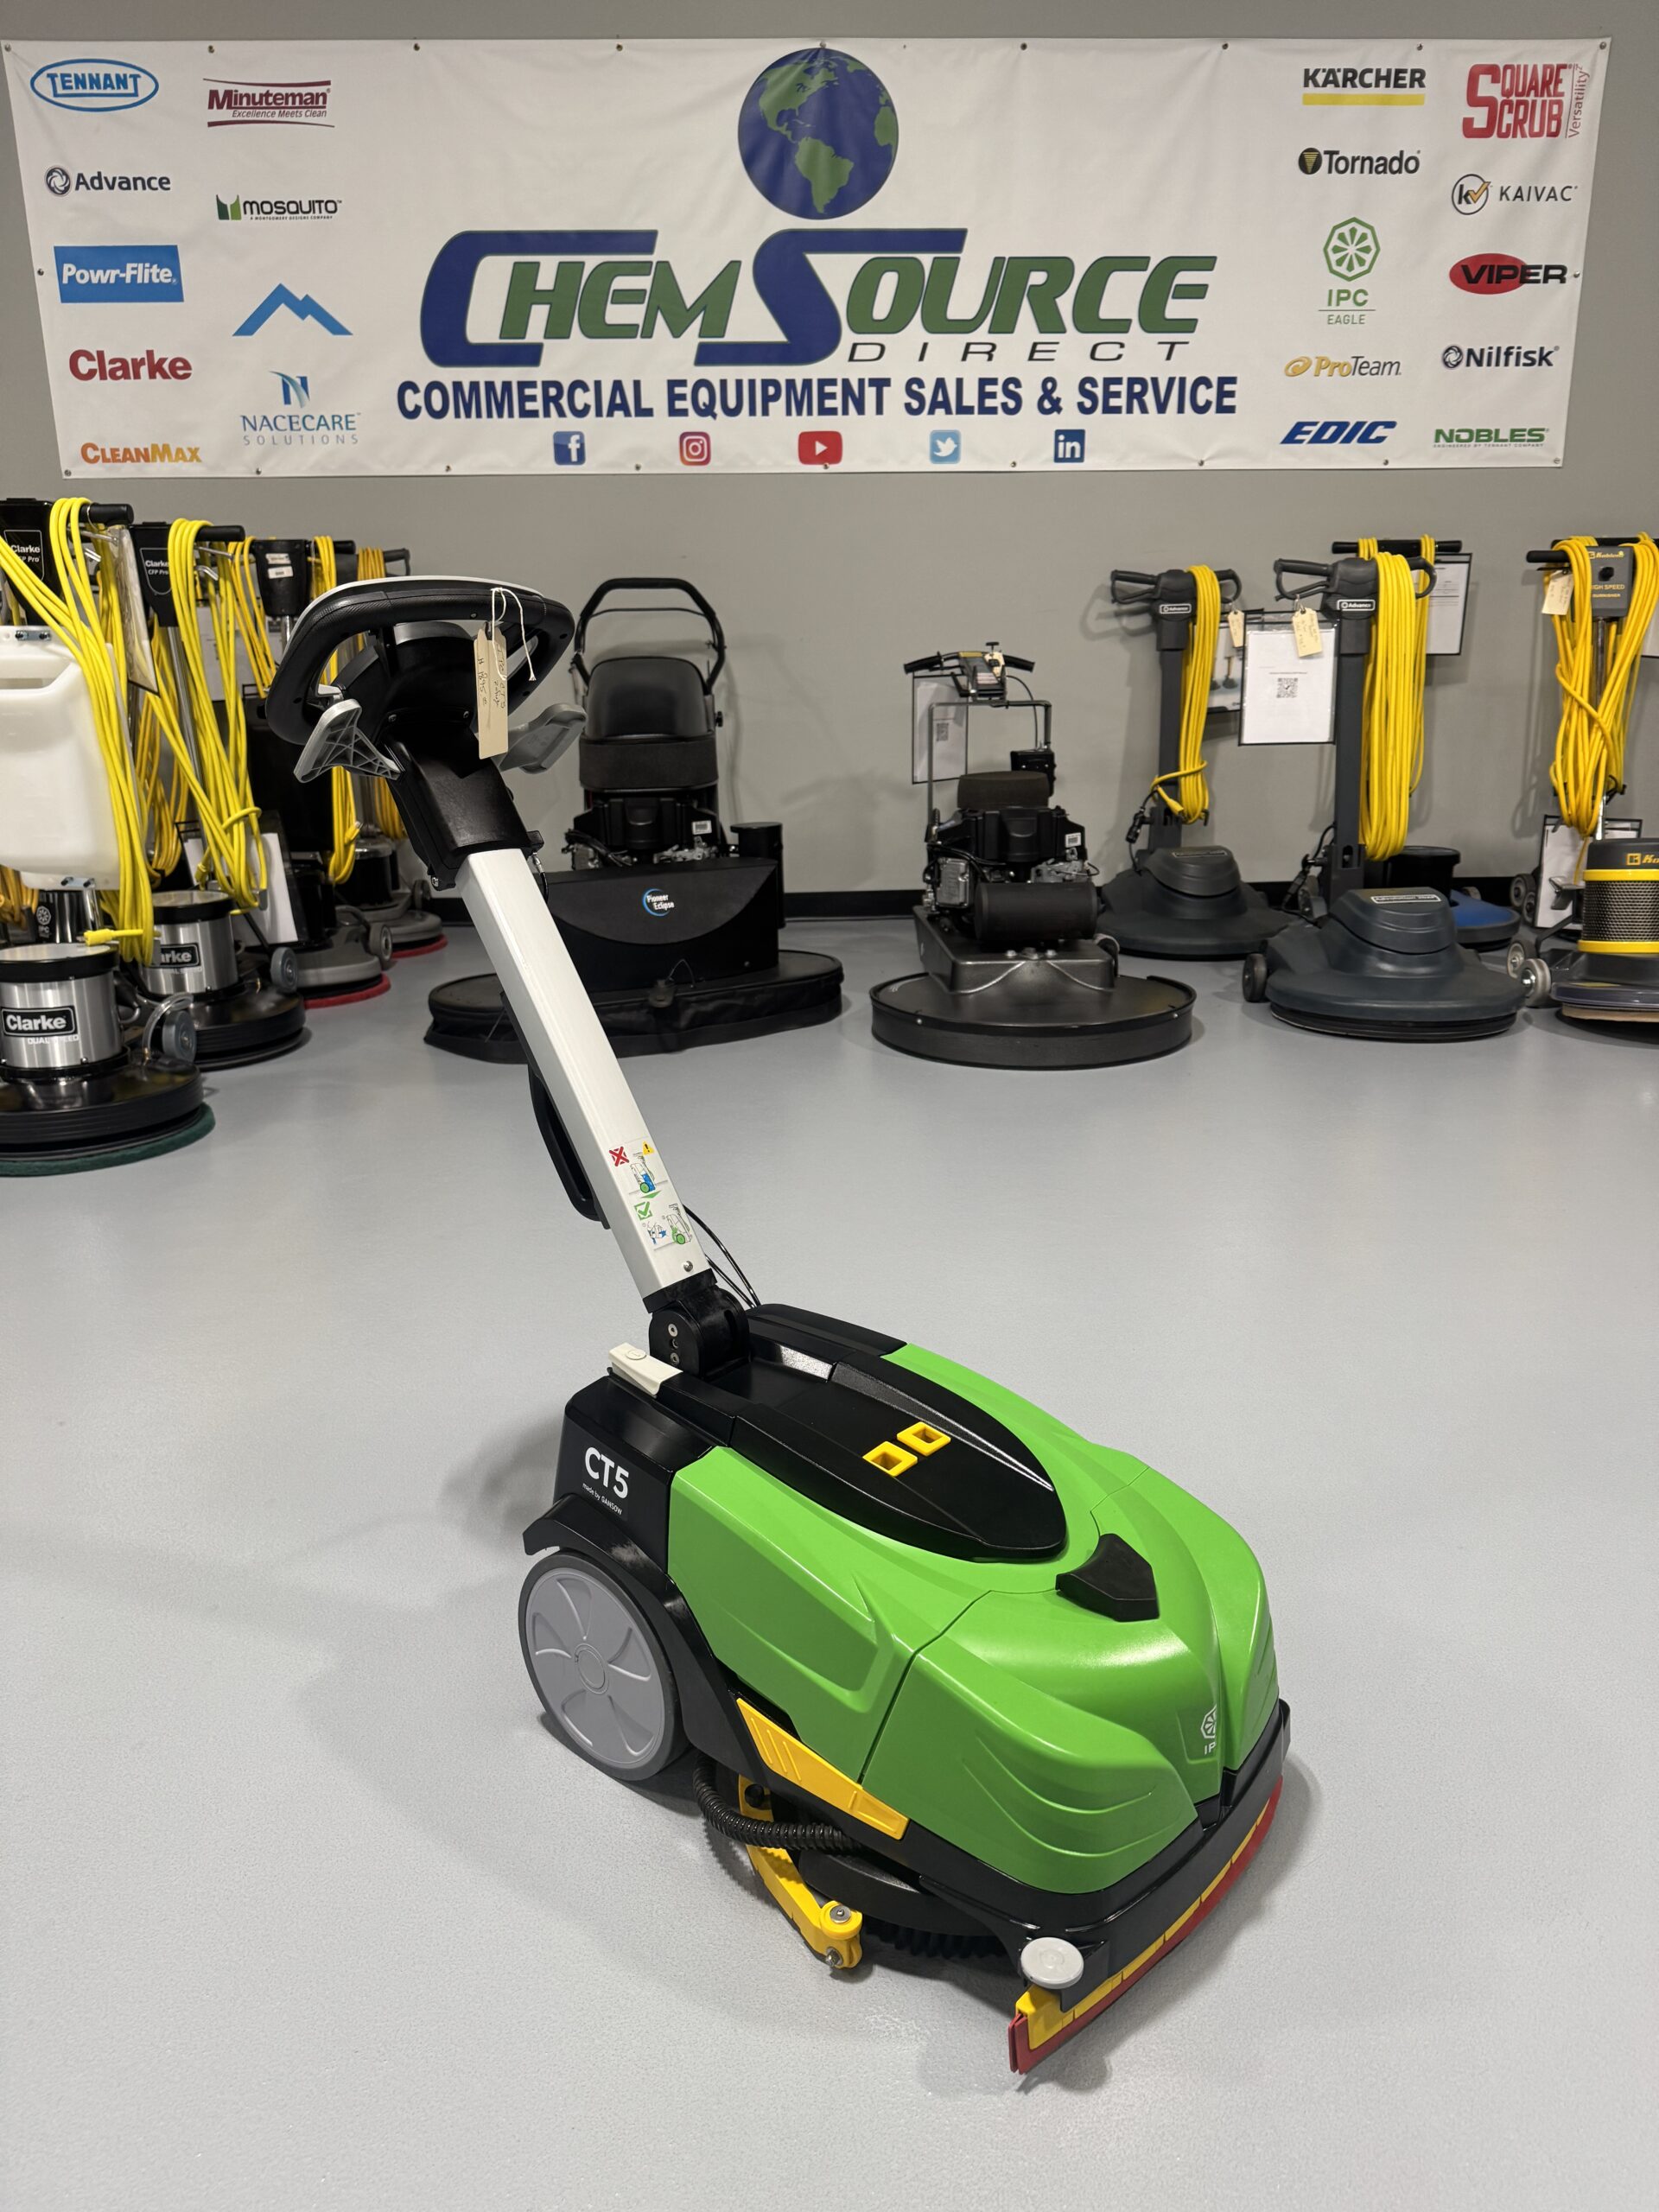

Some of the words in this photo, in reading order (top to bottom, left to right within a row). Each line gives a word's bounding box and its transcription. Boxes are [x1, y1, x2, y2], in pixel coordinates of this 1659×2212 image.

[47, 73, 141, 92] TENNANT
[1303, 67, 1426, 89] KÄRCHER
[208, 89, 327, 110] Minuteman
[1324, 150, 1420, 175] Tornado
[74, 171, 171, 192] Advance
[1500, 186, 1573, 201] KAIVAC
[62, 263, 174, 284] Powr-Flite
[1460, 264, 1567, 284] VIPER
[1328, 289, 1369, 307] IPC
[1327, 314, 1366, 325] EAGLE
[847, 341, 1190, 362] DIRECT
[1465, 346, 1554, 367] Nilfisk
[69, 349, 192, 381] Clarke
[1314, 356, 1401, 377] ProTeam
[397, 379, 653, 419] COMMERCIAL
[667, 377, 891, 420] EQUIPMENT
[904, 377, 1022, 416] SALES
[1037, 377, 1064, 415] &
[1077, 376, 1237, 415] SERVICE
[240, 414, 358, 431] NACECARE
[1280, 421, 1397, 445] EDIC
[243, 434, 359, 446] SOLUTIONS
[1434, 428, 1545, 443] NOBLES
[10, 544, 41, 553] Clarke
[646, 894, 668, 903] Pioneer
[654, 901, 675, 911] Eclipse
[7, 1014, 67, 1031] Clarke
[585, 1446, 629, 1499] CT5
[582, 1483, 595, 1496] made
[594, 1491, 601, 1501] by
[601, 1496, 622, 1516] GANSOW
